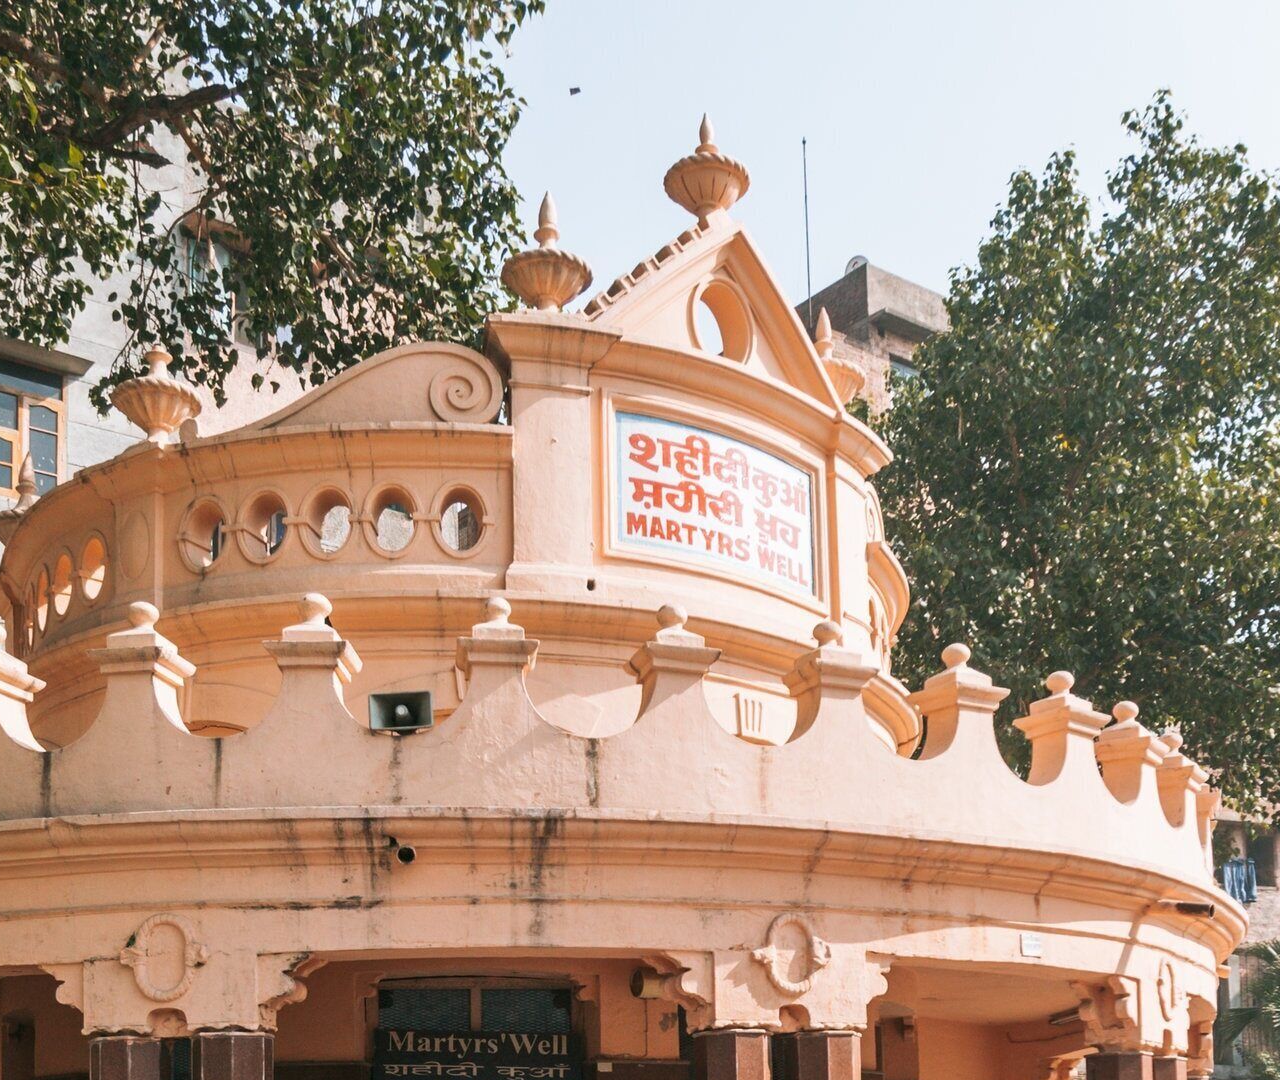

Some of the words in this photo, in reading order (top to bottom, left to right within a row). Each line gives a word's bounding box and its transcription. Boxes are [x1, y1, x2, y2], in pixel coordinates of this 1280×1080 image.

[628, 433, 750, 491] शहीदी
[756, 543, 809, 588] WELL
[383, 1061, 485, 1079] शहीदी
